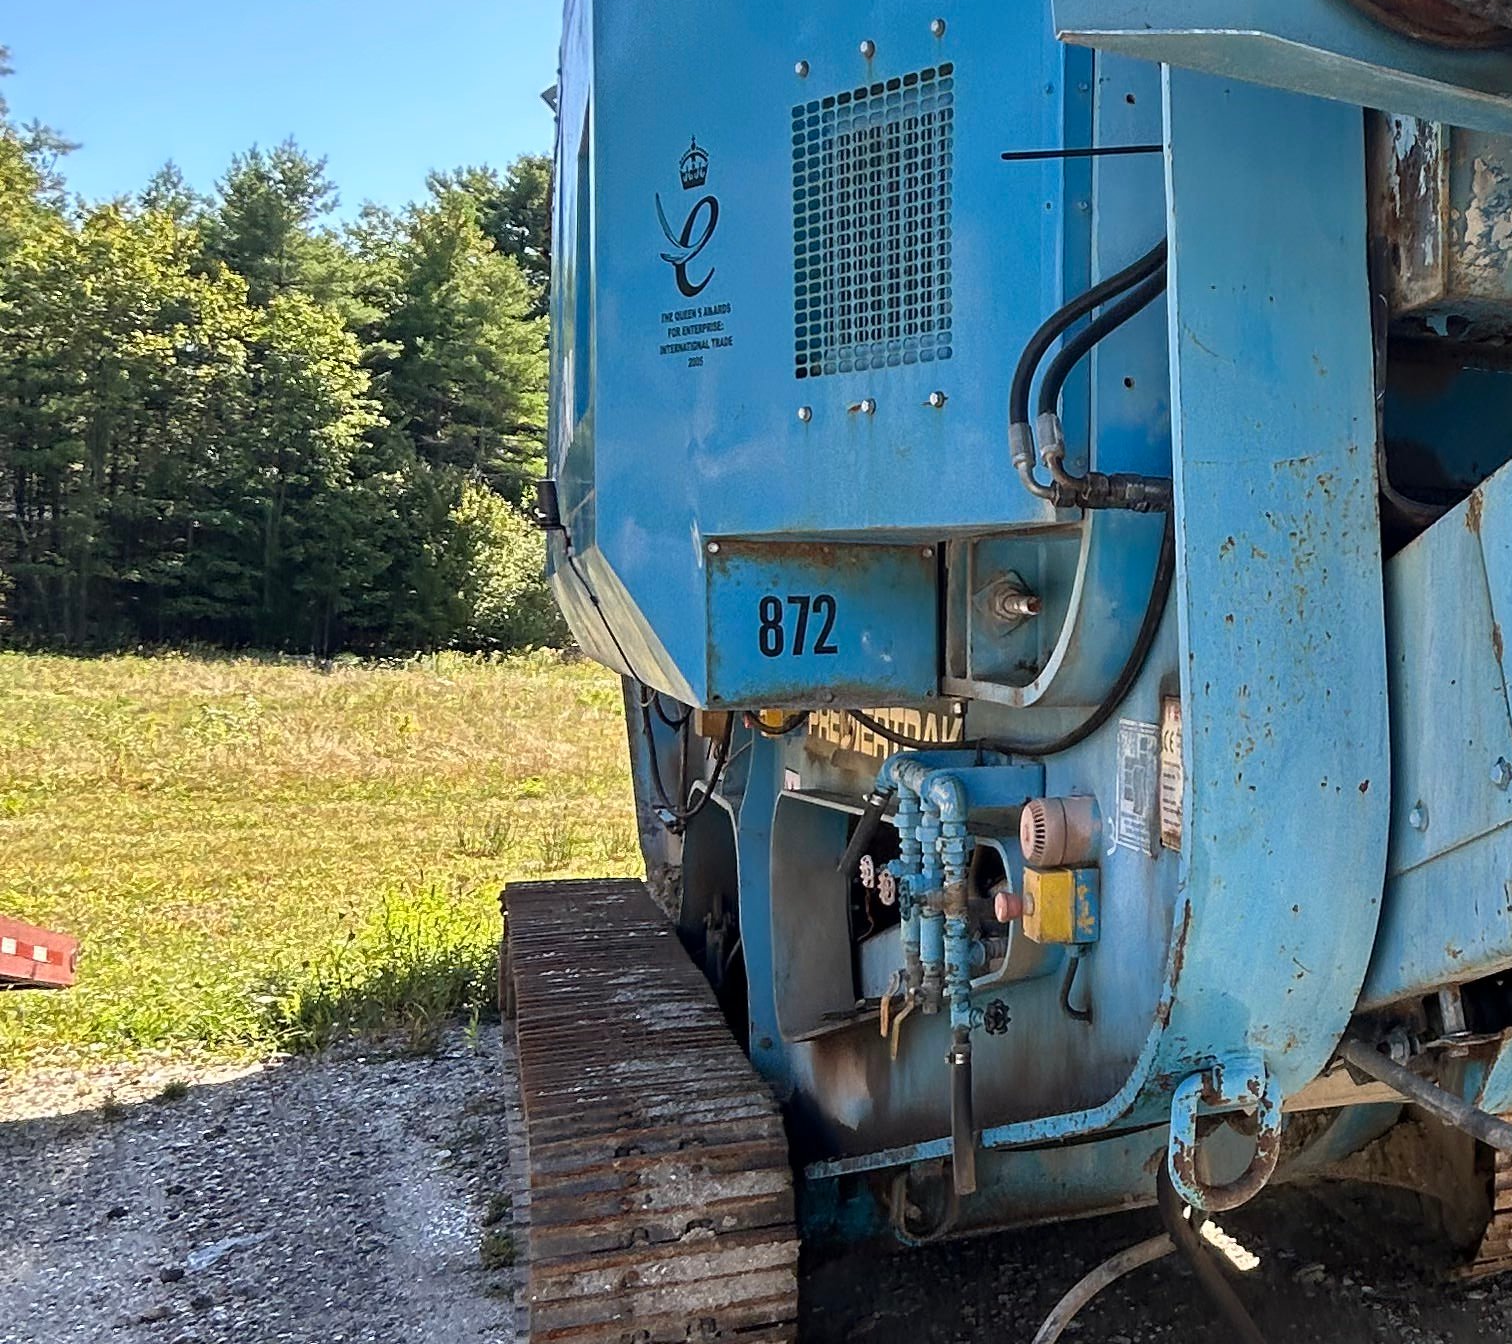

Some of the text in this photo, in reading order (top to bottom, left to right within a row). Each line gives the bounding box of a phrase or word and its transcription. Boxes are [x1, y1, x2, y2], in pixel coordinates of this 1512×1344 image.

[674, 307, 702, 322] QUEENS
[667, 326, 681, 338] FOR
[660, 336, 733, 355] INTERNATIONAL TRADE
[759, 594, 838, 657] 872
